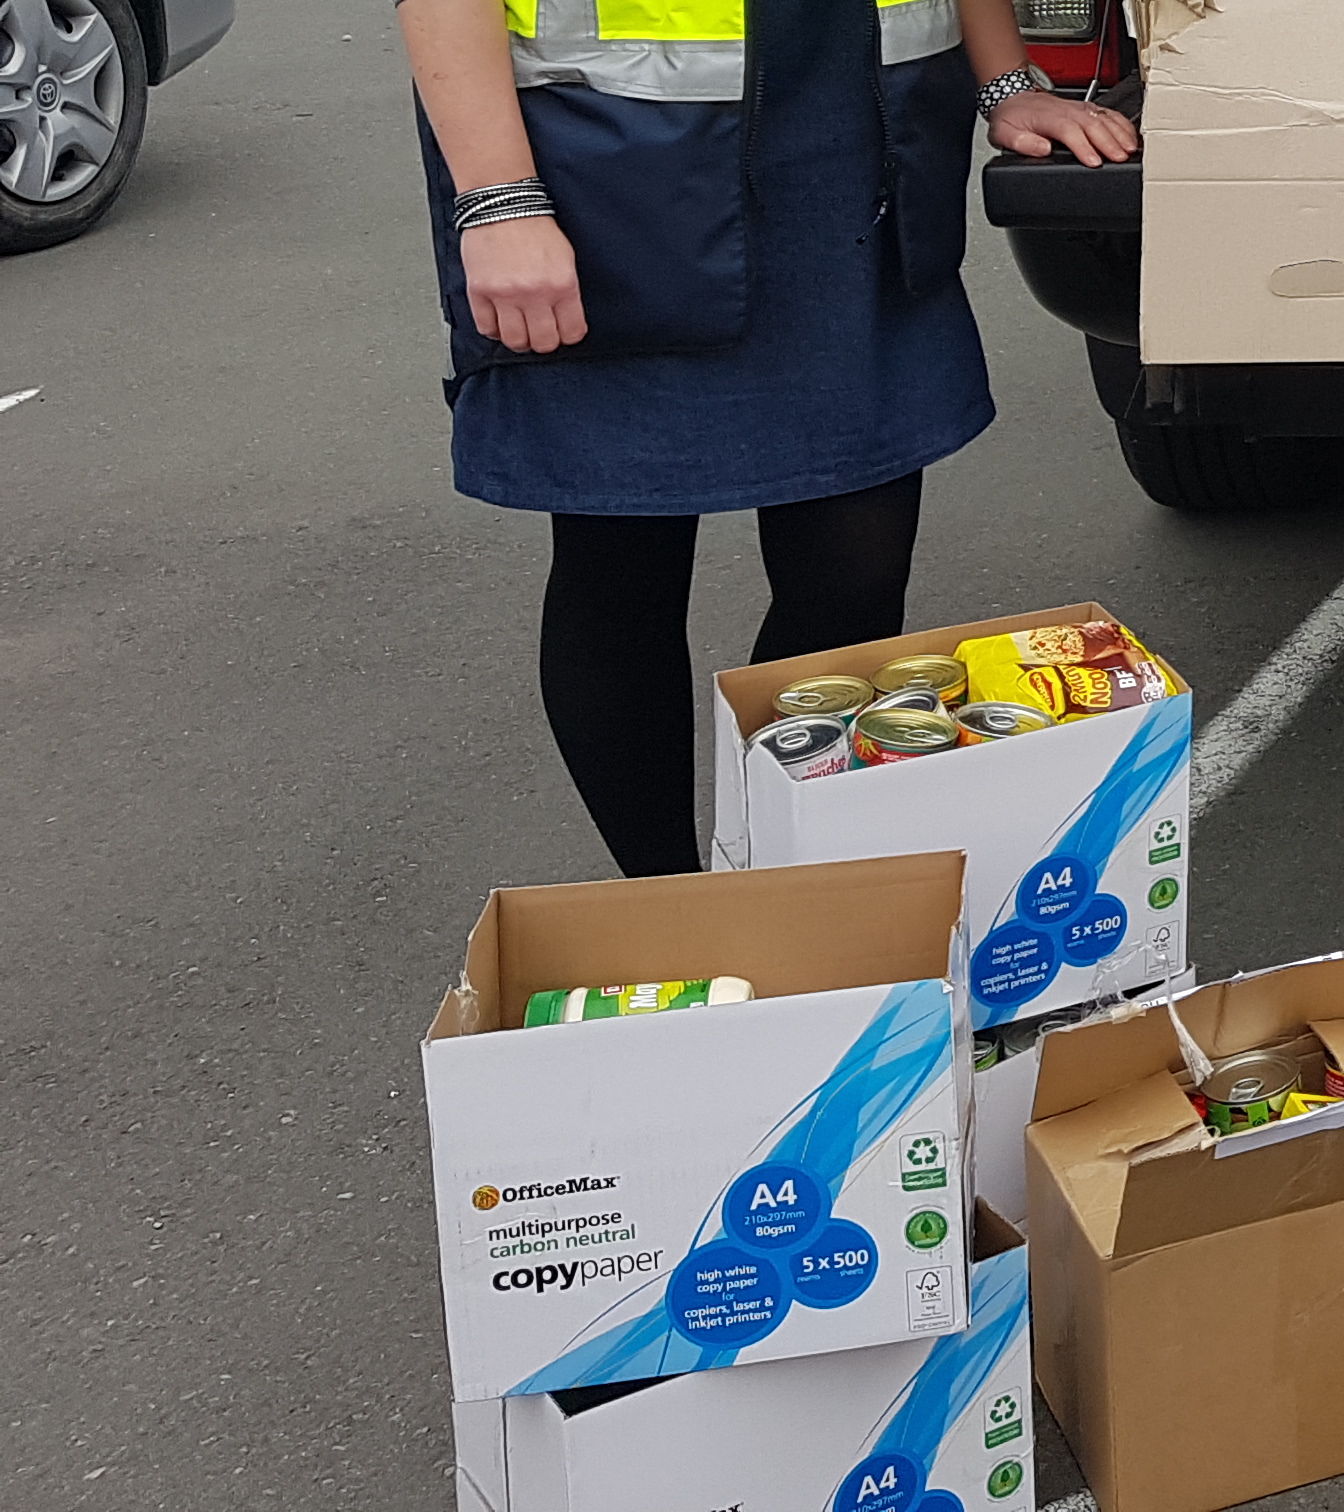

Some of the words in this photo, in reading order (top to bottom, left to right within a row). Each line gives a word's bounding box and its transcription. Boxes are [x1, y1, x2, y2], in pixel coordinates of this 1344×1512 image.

[1088, 667, 1113, 707] Noo
[1036, 867, 1073, 895] A4
[1039, 901, 1069, 916] 80gsm
[1071, 926, 1081, 940] 5
[1083, 925, 1093, 936] x
[1094, 915, 1121, 933] 500
[992, 944, 1011, 956] high
[1014, 938, 1038, 951] white
[992, 953, 1012, 965] copy
[1014, 947, 1038, 962] paper
[980, 971, 1015, 986] copiers,
[1017, 965, 1039, 977] laser
[1041, 962, 1049, 971] &
[982, 982, 1009, 995] inkjet
[1010, 973, 1046, 990] printers
[629, 983, 662, 1009] May
[502, 1176, 617, 1203] OfficeMax
[750, 1180, 798, 1211] A4
[488, 1211, 622, 1242] multipurpose
[744, 1210, 806, 1225] 210x297mm
[489, 1238, 559, 1259] carbon
[565, 1223, 636, 1249] neutral
[755, 1224, 796, 1238] 80gsm
[492, 1249, 664, 1294] copypaper
[802, 1256, 814, 1273] 5
[818, 1256, 830, 1269] x
[833, 1249, 869, 1268] 500
[696, 1267, 722, 1282] high
[725, 1265, 757, 1277] white
[697, 1280, 723, 1294] copy
[726, 1277, 759, 1292] paper
[684, 1304, 731, 1321] copiers,
[733, 1300, 761, 1312] laser
[764, 1296, 774, 1307] &
[722, 1292, 735, 1301] for
[688, 1315, 723, 1330] inkjet
[725, 1310, 772, 1326] printers
[856, 1466, 898, 1503] A4
